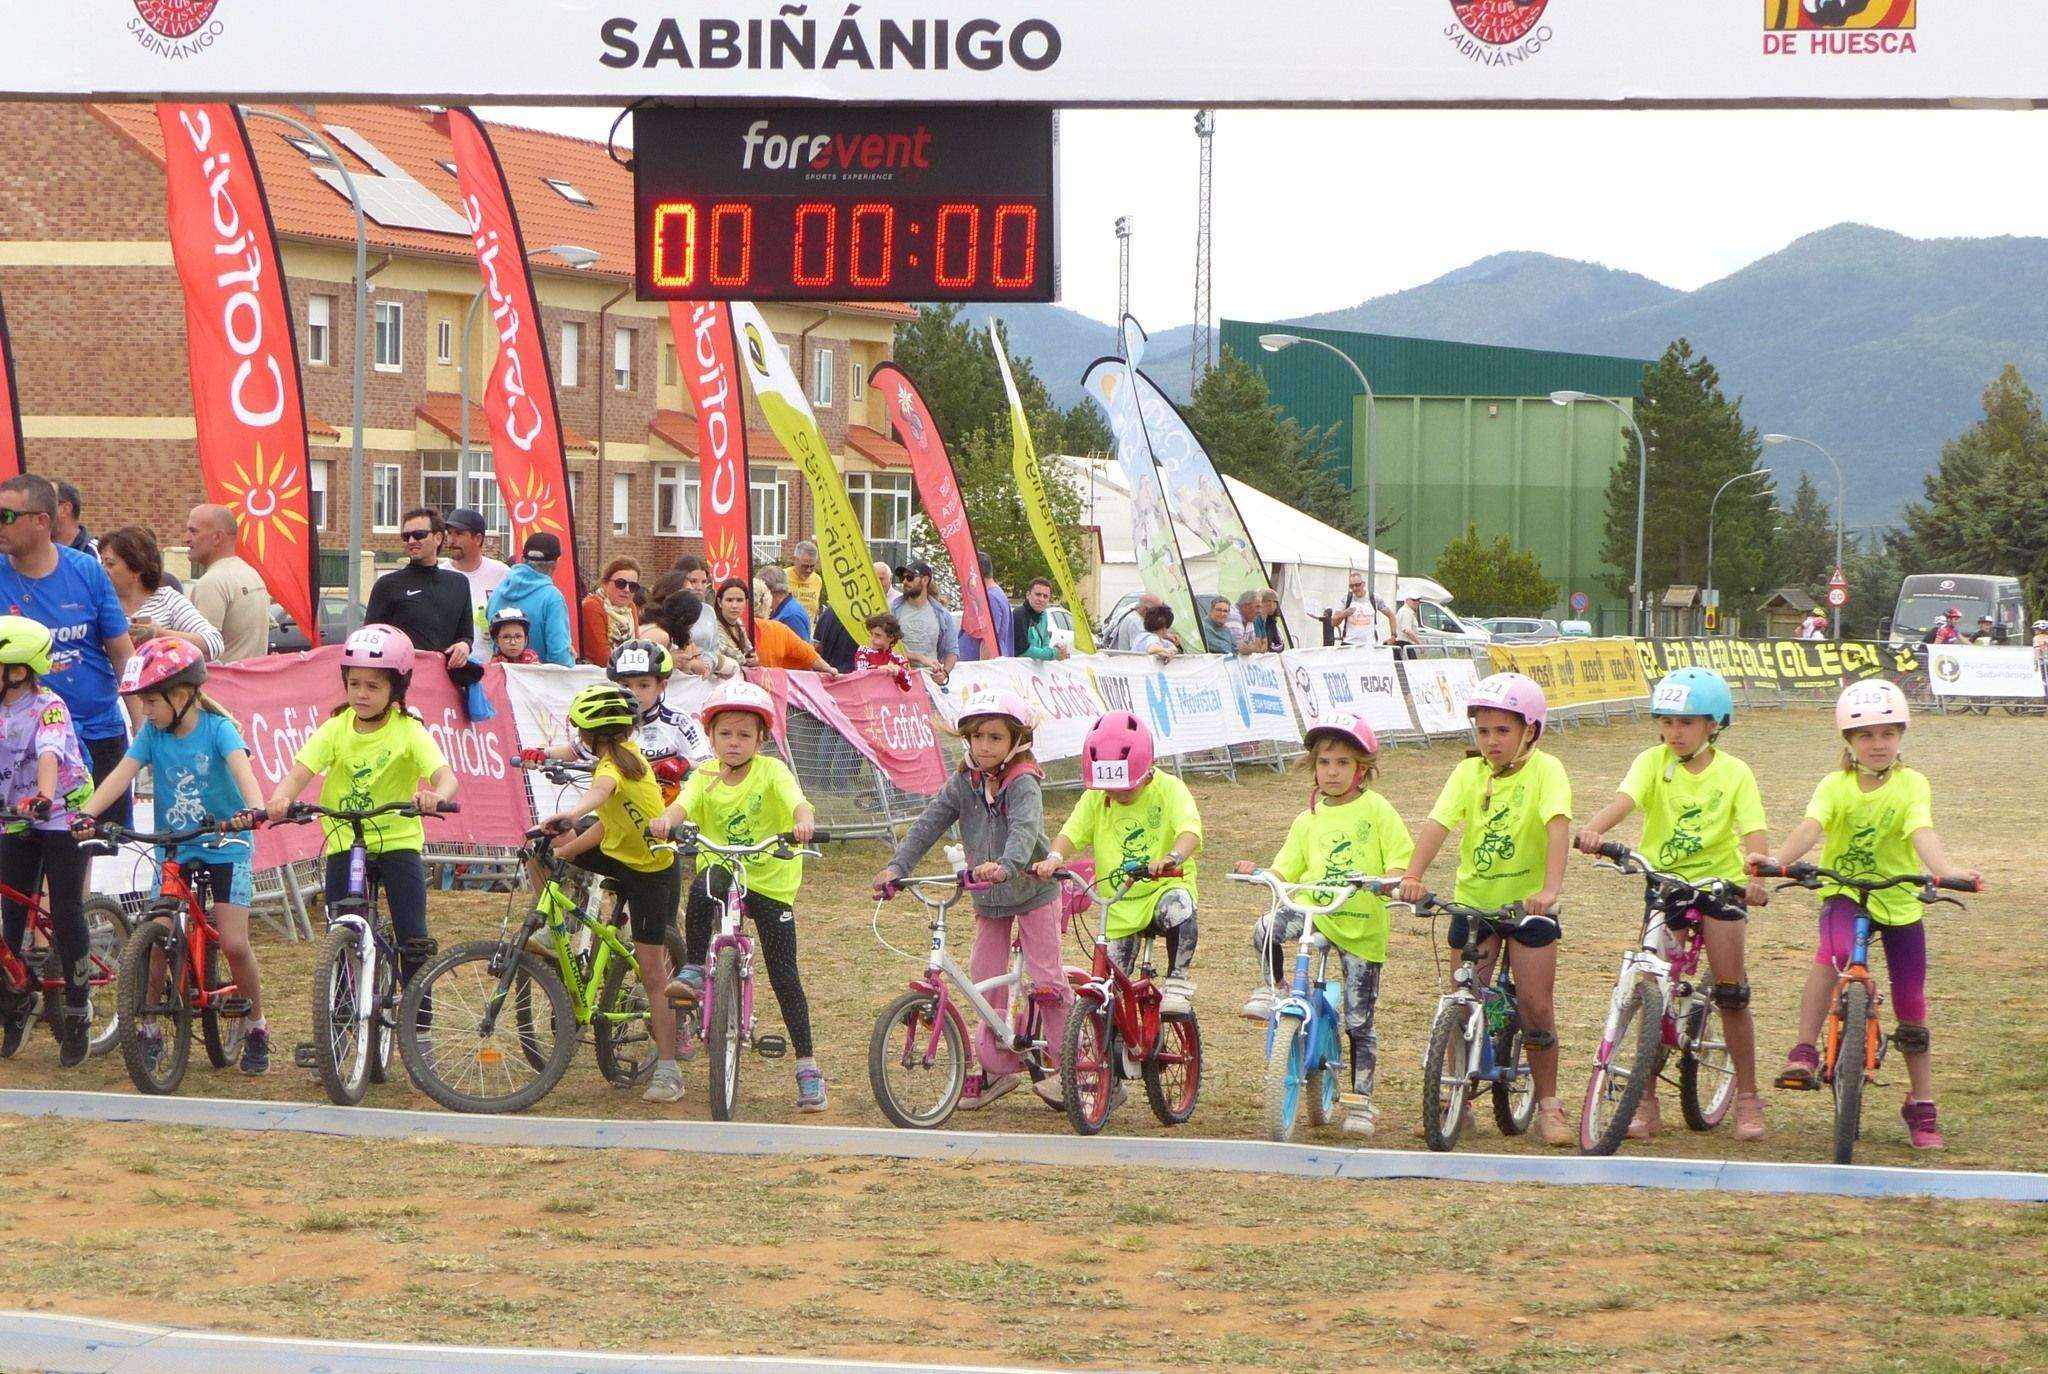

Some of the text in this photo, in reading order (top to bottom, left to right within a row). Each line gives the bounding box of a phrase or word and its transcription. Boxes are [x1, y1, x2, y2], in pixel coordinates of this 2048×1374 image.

[150, 1, 203, 21] CICLISTA
[1469, 4, 1529, 27] CICLISTA
[1482, 0, 1516, 13] CLUB
[138, 1, 214, 35] EDELWEISS
[1456, 4, 1541, 42] EDELWEISS
[126, 18, 224, 60] SABIÑÁNIGO
[599, 3, 1062, 71] SABIÑÁNIGO
[1443, 23, 1553, 67] SABIÑÁNIGO
[1763, 32, 1917, 55] DE HUESCA
[741, 120, 932, 170] forevent
[805, 173, 893, 181] SPORTS EXPERIENCE
[353, 632, 381, 646] 118
[621, 653, 645, 665] 116
[1360, 675, 1394, 697] RIDLEY
[1479, 682, 1502, 695] 121
[1658, 689, 1683, 703] 122
[971, 693, 996, 706] 124
[1854, 692, 1882, 705] 119
[880, 702, 935, 750] Cofidis
[408, 705, 506, 781] ofidis
[1095, 763, 1125, 781] 114
[622, 800, 646, 830] LCL
